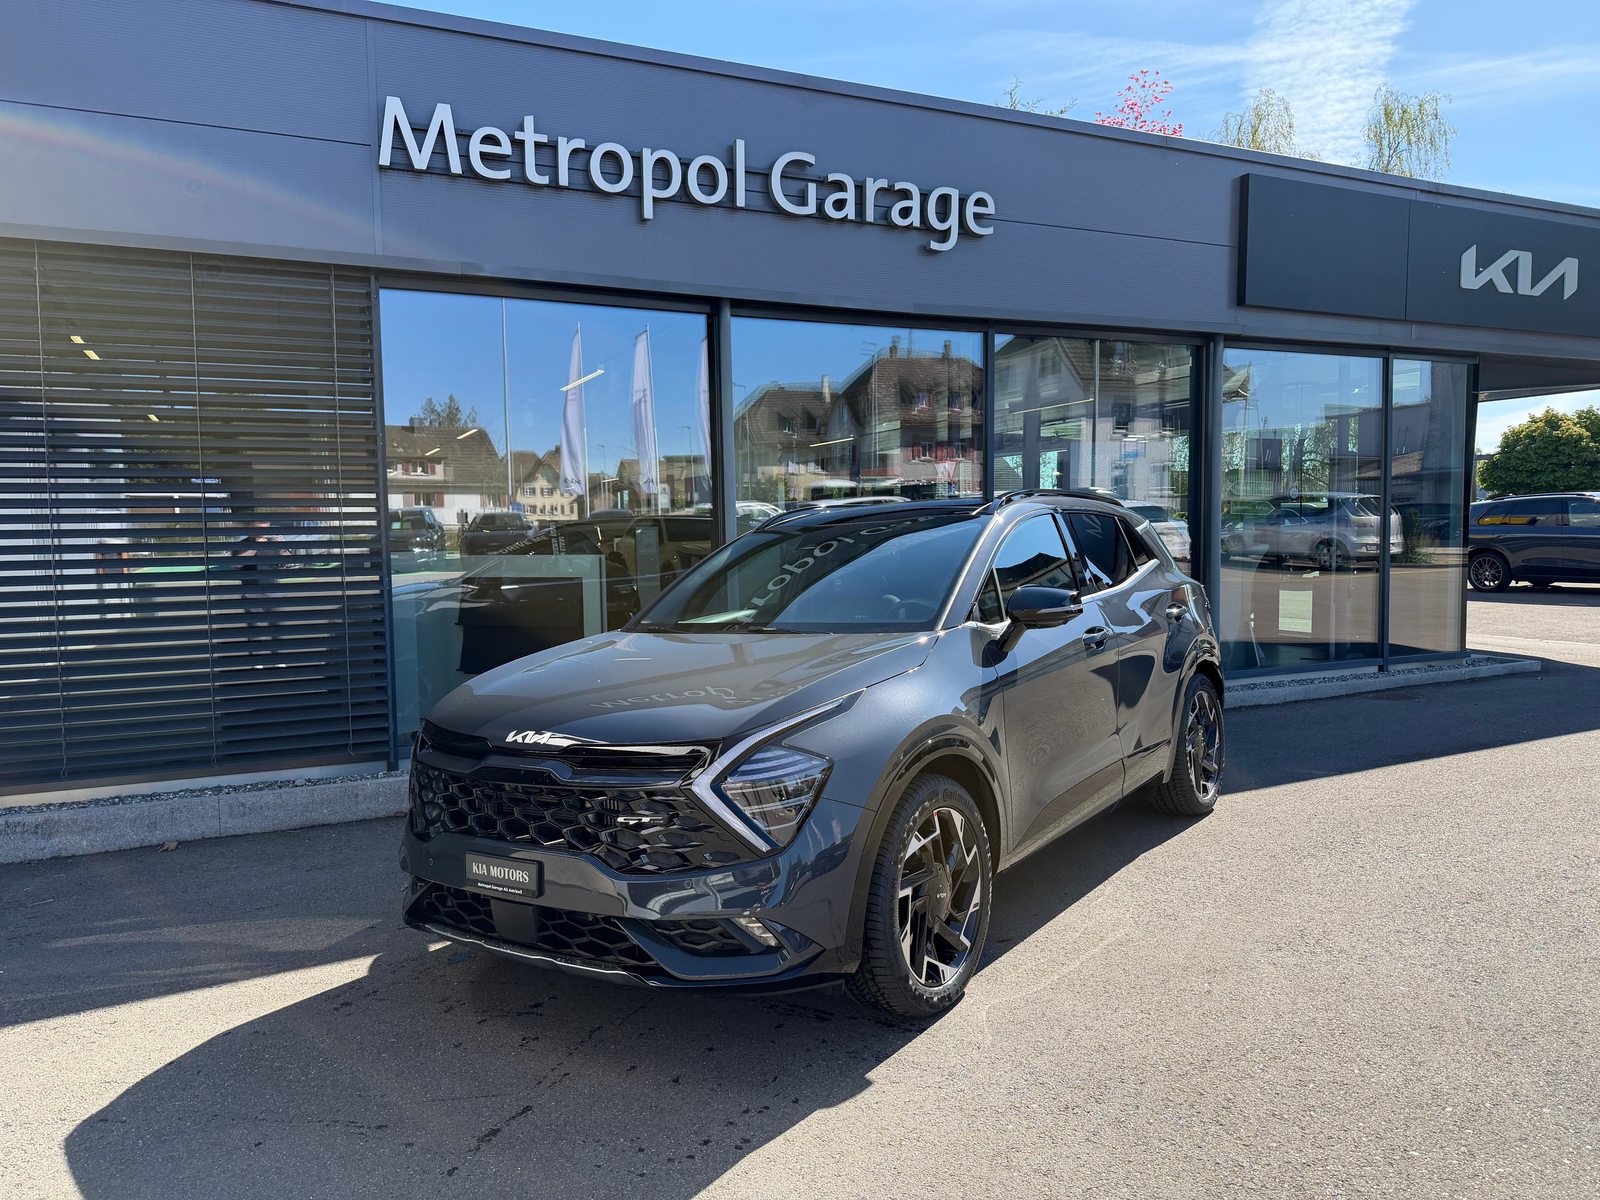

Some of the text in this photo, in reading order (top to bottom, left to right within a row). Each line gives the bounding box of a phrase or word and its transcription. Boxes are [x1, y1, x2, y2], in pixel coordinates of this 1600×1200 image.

[378, 95, 996, 251] Metropol Garage
[1460, 243, 1579, 300] KIA
[505, 730, 552, 744] KIA
[472, 862, 529, 883] KIA MOTORS
